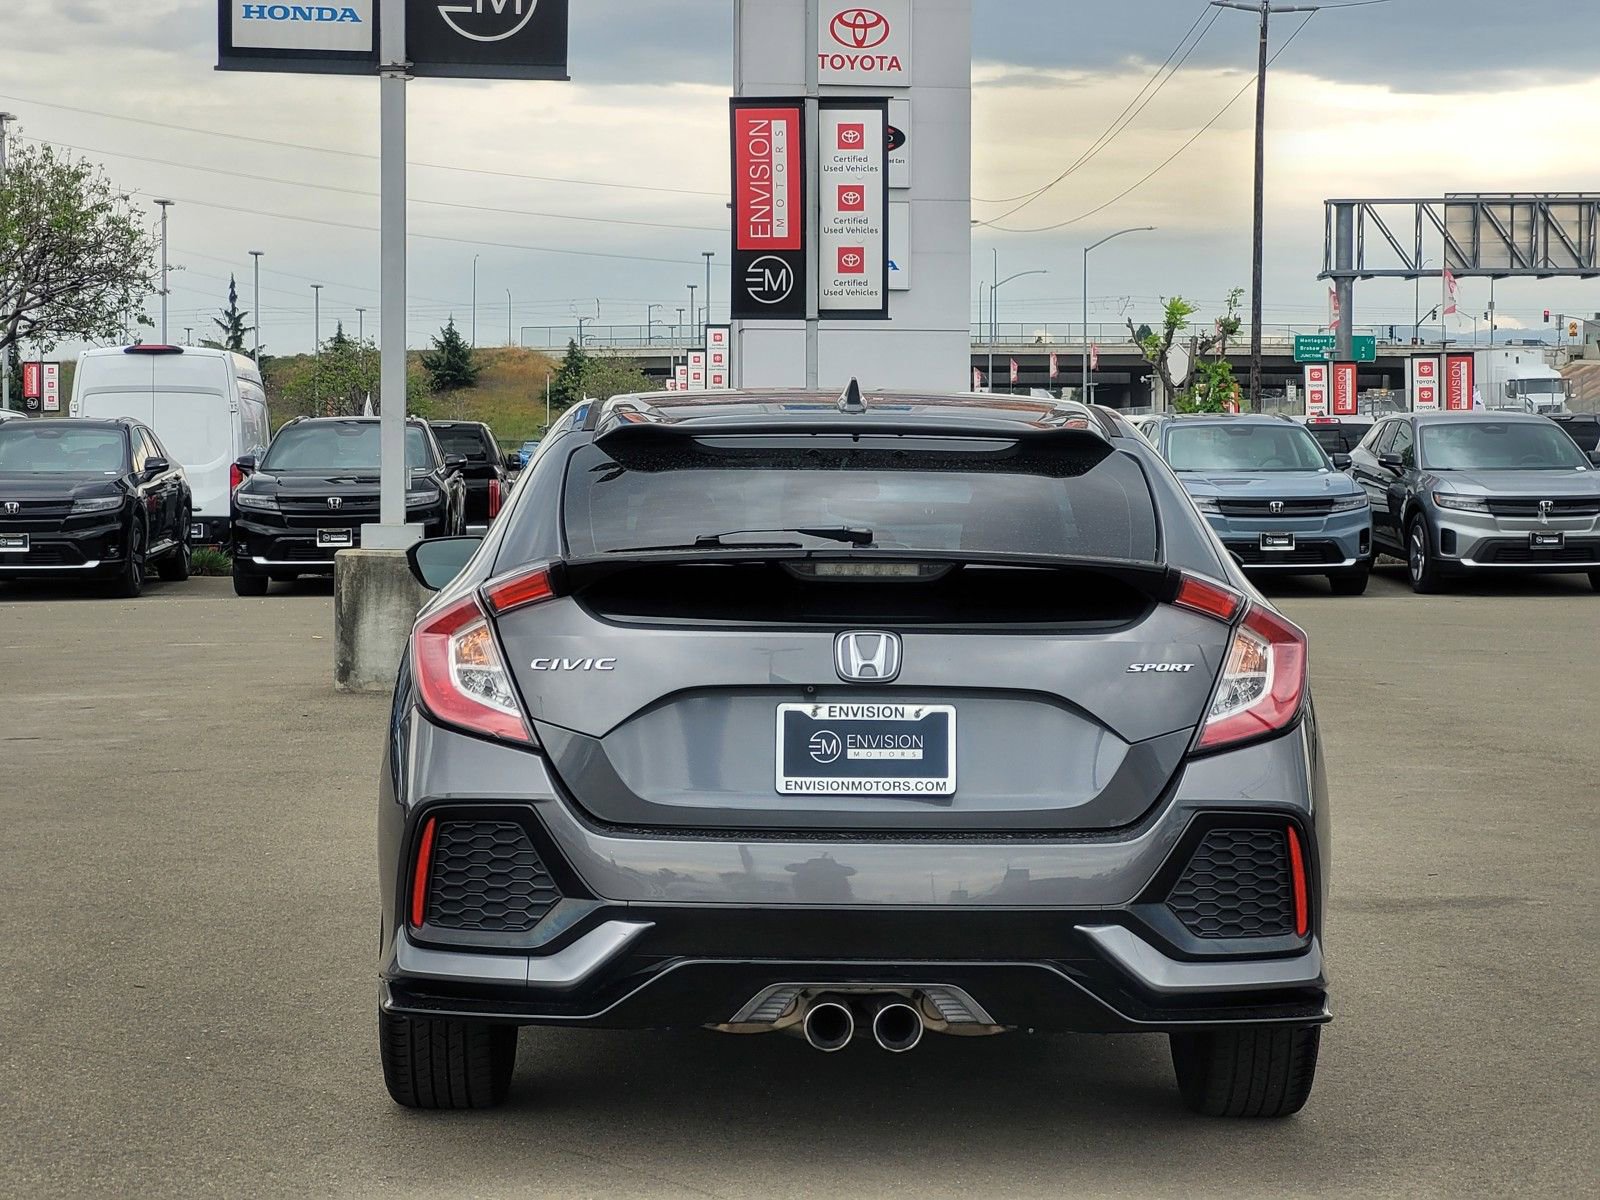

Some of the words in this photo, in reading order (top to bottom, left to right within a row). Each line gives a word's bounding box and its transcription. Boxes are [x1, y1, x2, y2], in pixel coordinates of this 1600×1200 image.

[241, 4, 362, 23] HONDA
[818, 54, 902, 71] TOYOTA
[833, 155, 868, 163] Certified
[749, 119, 771, 238] ENVISION
[775, 130, 785, 228] MOTORS
[833, 217, 868, 225] Certified
[833, 279, 868, 287] Certified
[1452, 362, 1460, 409] ENVISION
[530, 658, 617, 671] CIVIC
[1126, 663, 1195, 673] SPORT
[828, 706, 905, 718] ENVISION
[847, 734, 923, 748] ENVISION
[785, 780, 947, 792] ENVISIONMOTORS.COM
